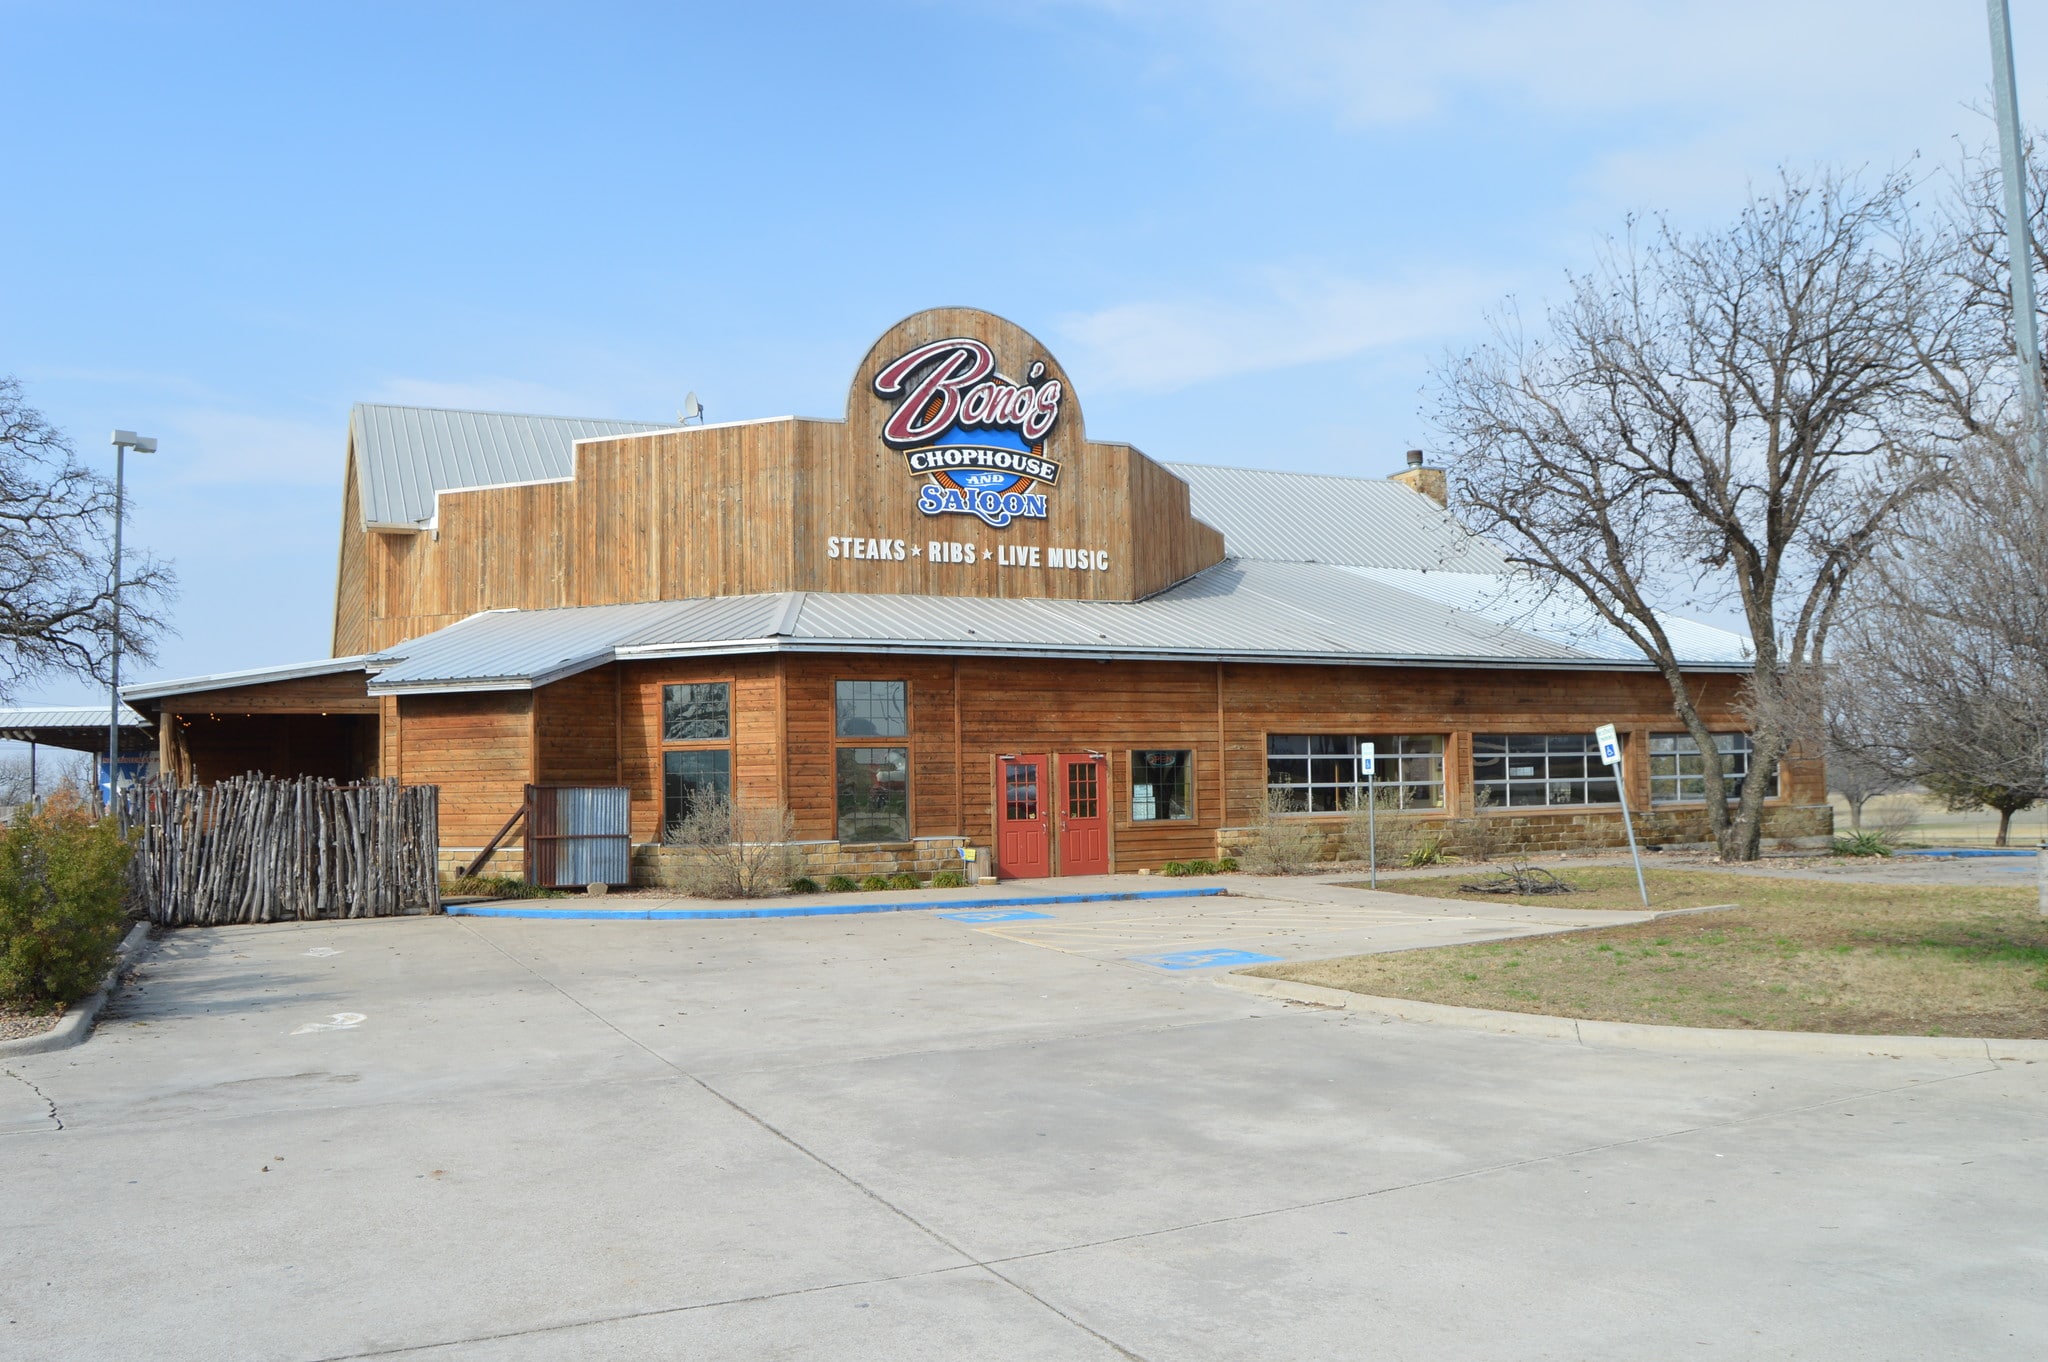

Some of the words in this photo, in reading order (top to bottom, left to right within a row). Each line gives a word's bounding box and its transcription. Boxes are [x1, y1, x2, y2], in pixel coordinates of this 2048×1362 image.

[874, 337, 1061, 443] Bono's
[910, 449, 1056, 480] CHOPHOUSE
[966, 474, 1005, 484] AND
[918, 484, 1048, 527] SALOON
[827, 536, 906, 561] STEAKS
[928, 541, 976, 564] RIBS
[998, 544, 1041, 567] LIVE
[1047, 547, 1109, 571] MUSIC
